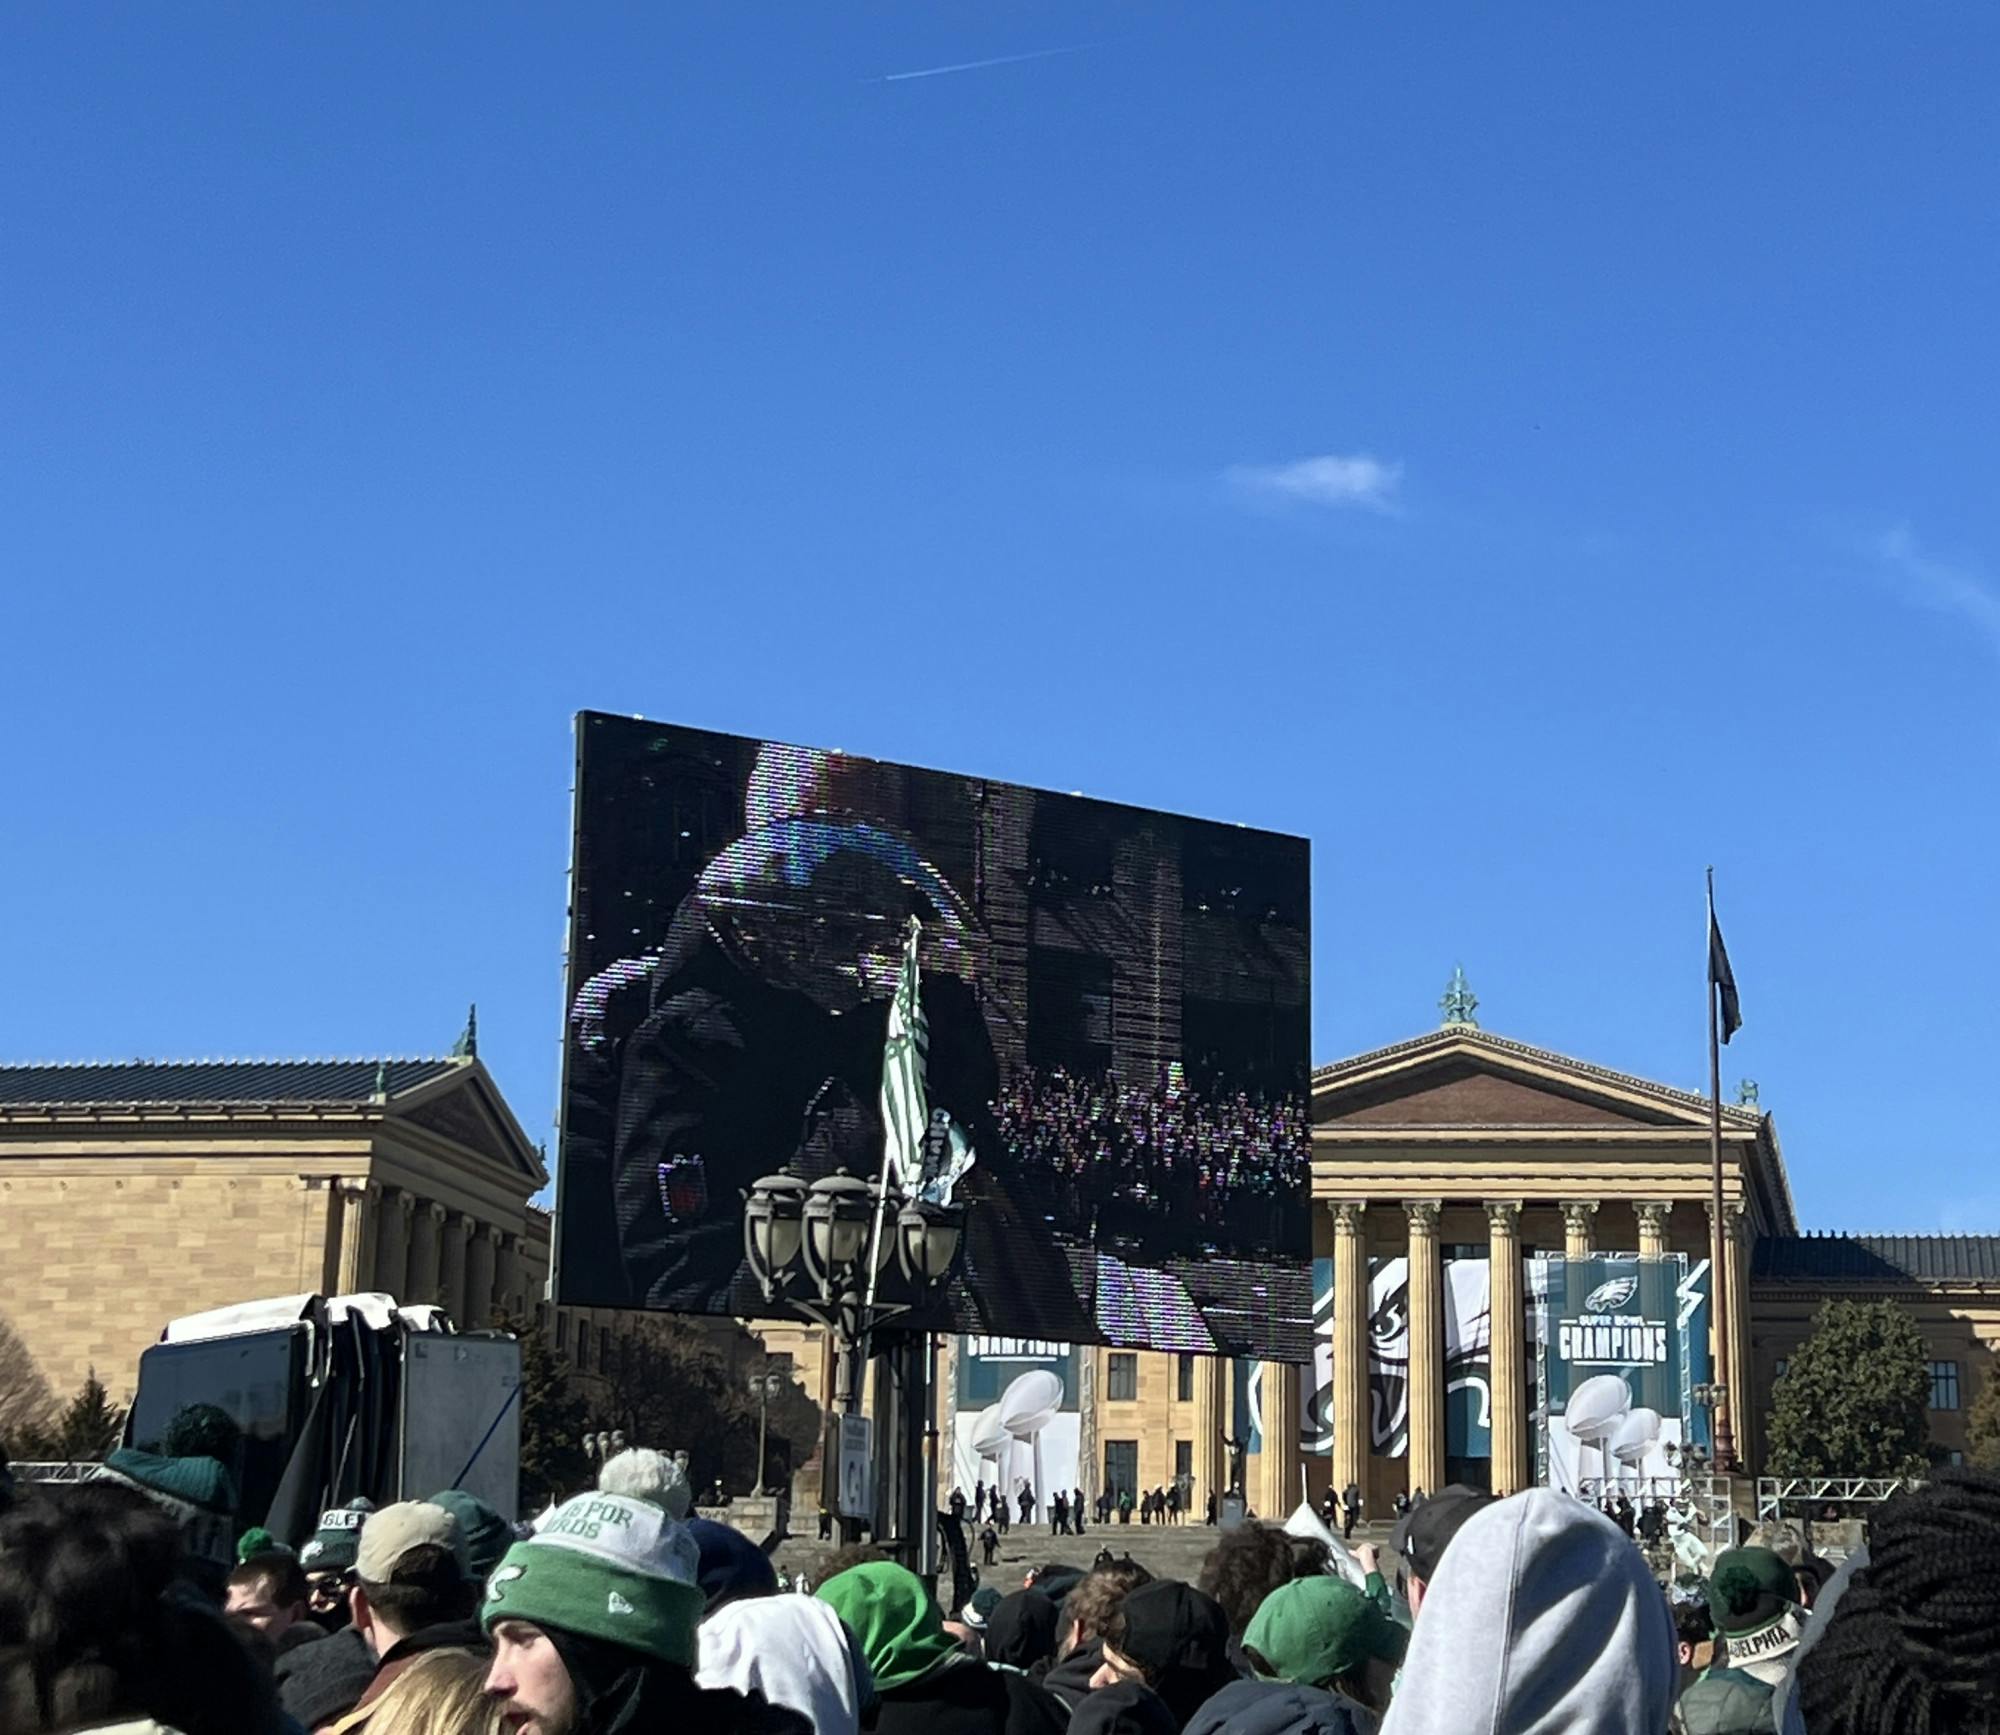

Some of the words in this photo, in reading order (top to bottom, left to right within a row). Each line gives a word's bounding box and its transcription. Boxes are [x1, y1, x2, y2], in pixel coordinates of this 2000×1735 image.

[1579, 1315, 1612, 1327] SUPER
[1614, 1315, 1645, 1327] BOWL
[1559, 1326, 1667, 1362] CHAMPIONS
